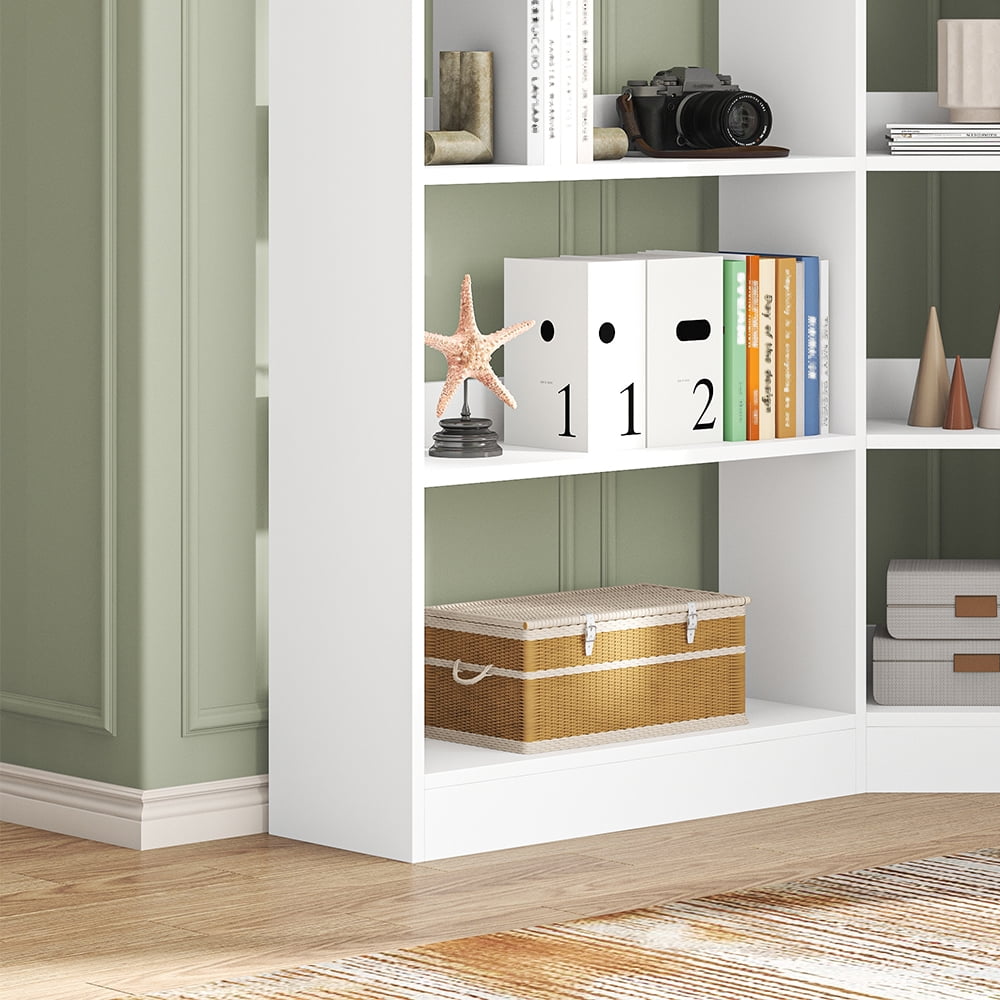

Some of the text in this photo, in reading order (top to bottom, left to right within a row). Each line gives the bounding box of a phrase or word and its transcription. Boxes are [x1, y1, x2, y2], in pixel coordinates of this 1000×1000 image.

[557, 383, 577, 438] 1
[620, 381, 642, 436] 1
[692, 377, 717, 431] 2
